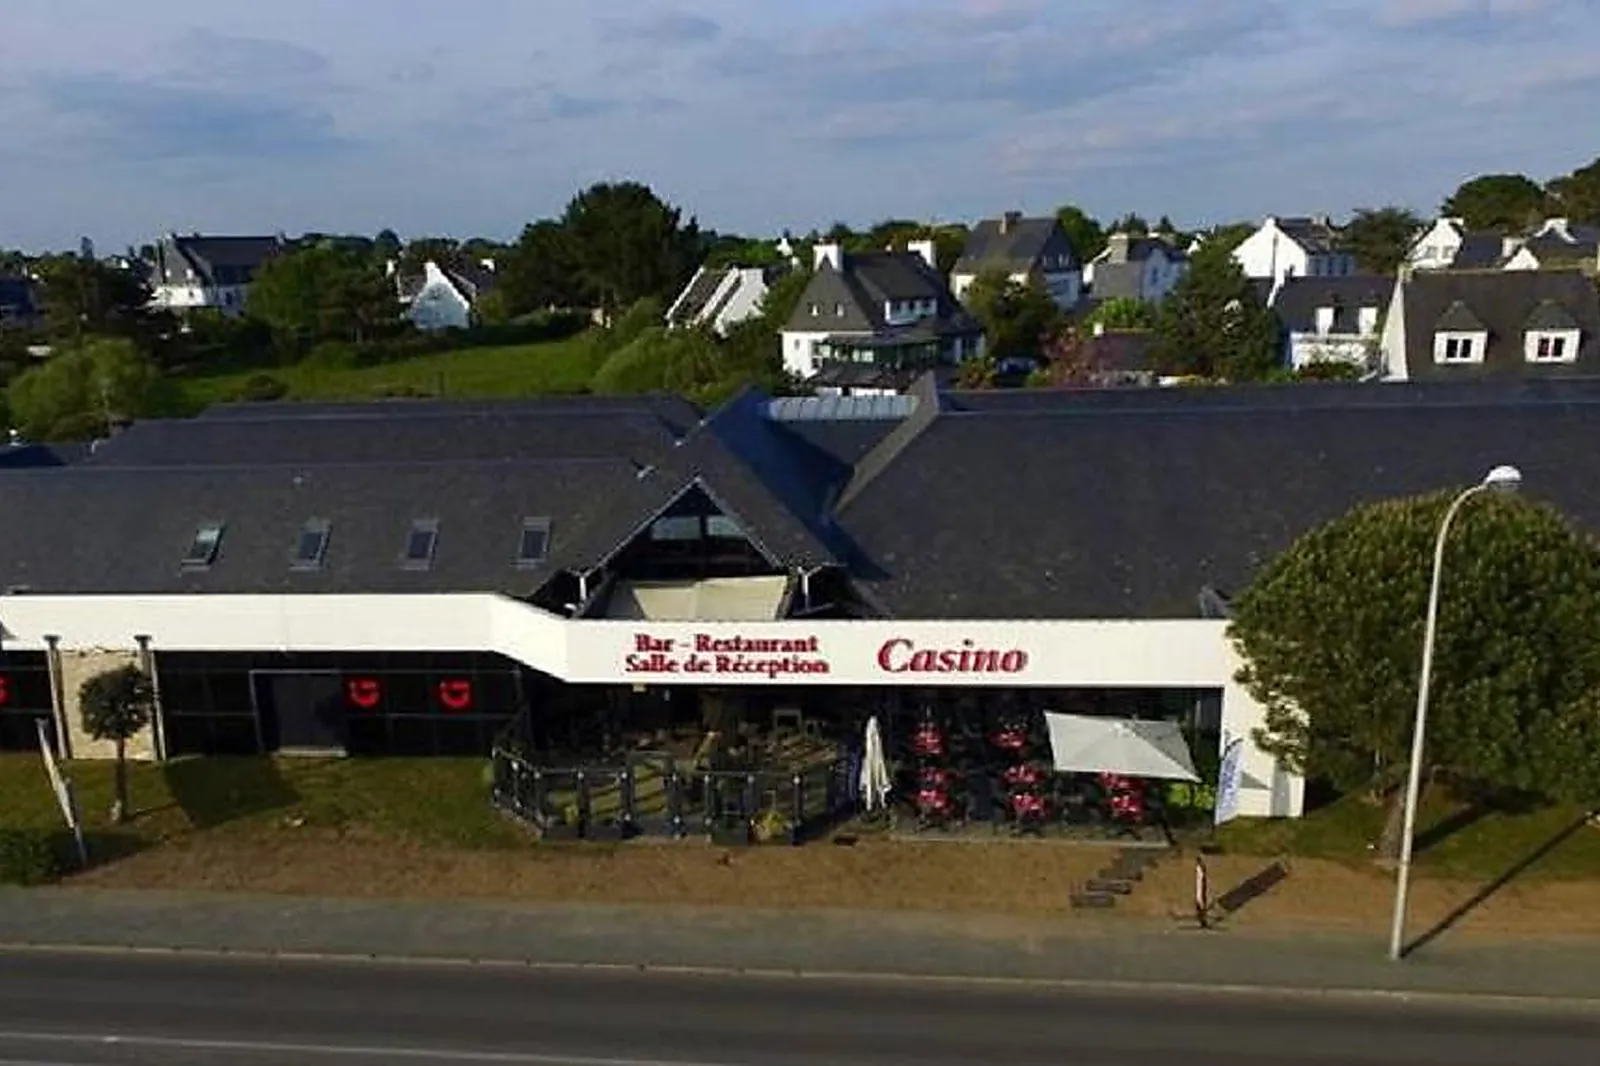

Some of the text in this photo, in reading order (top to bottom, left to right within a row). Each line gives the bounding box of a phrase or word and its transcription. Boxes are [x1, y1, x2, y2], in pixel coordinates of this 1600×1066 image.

[635, 634, 674, 652] Bar
[696, 634, 819, 652] Restaurant
[625, 654, 829, 678] Salle de Réception
[877, 638, 1029, 673] Casino
